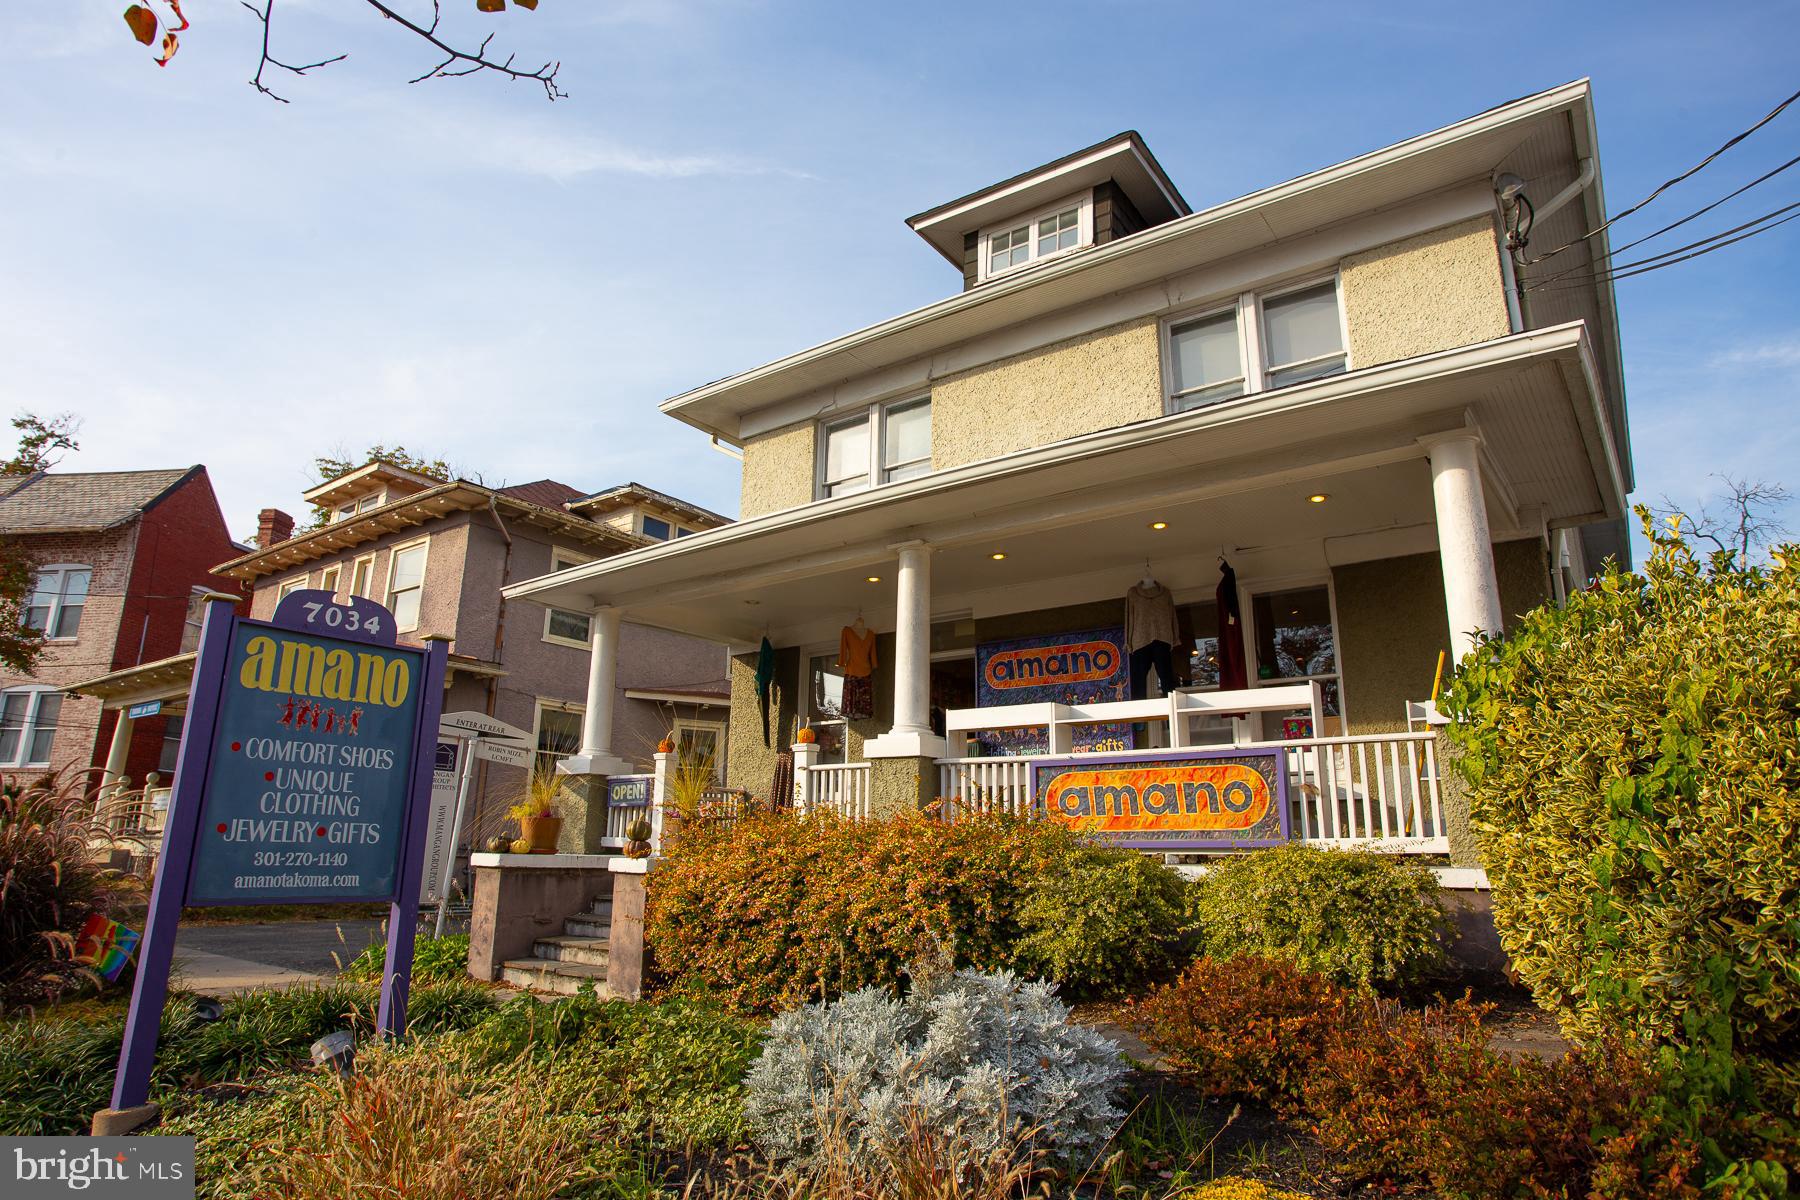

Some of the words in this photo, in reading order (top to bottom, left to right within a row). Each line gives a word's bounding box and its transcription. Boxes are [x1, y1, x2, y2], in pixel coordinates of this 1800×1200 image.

[303, 601, 380, 635] 7034
[240, 636, 410, 708] amano
[992, 649, 1112, 681] amano
[456, 718, 478, 729] ENTER
[478, 723, 487, 731] AT
[487, 725, 505, 735] REAR
[246, 737, 339, 763] COMFORT
[339, 746, 394, 770] SHOES
[1095, 737, 1124, 753] gifts
[275, 767, 354, 793] UNIQUE
[612, 783, 645, 801] OPEN!
[260, 791, 361, 817] CLOTHING
[1056, 779, 1255, 818] amano
[223, 818, 318, 843] JEWELRY
[327, 823, 380, 844] GIFTS
[254, 851, 348, 867] 301-270-1140
[234, 873, 360, 889] amanotakoma.com
